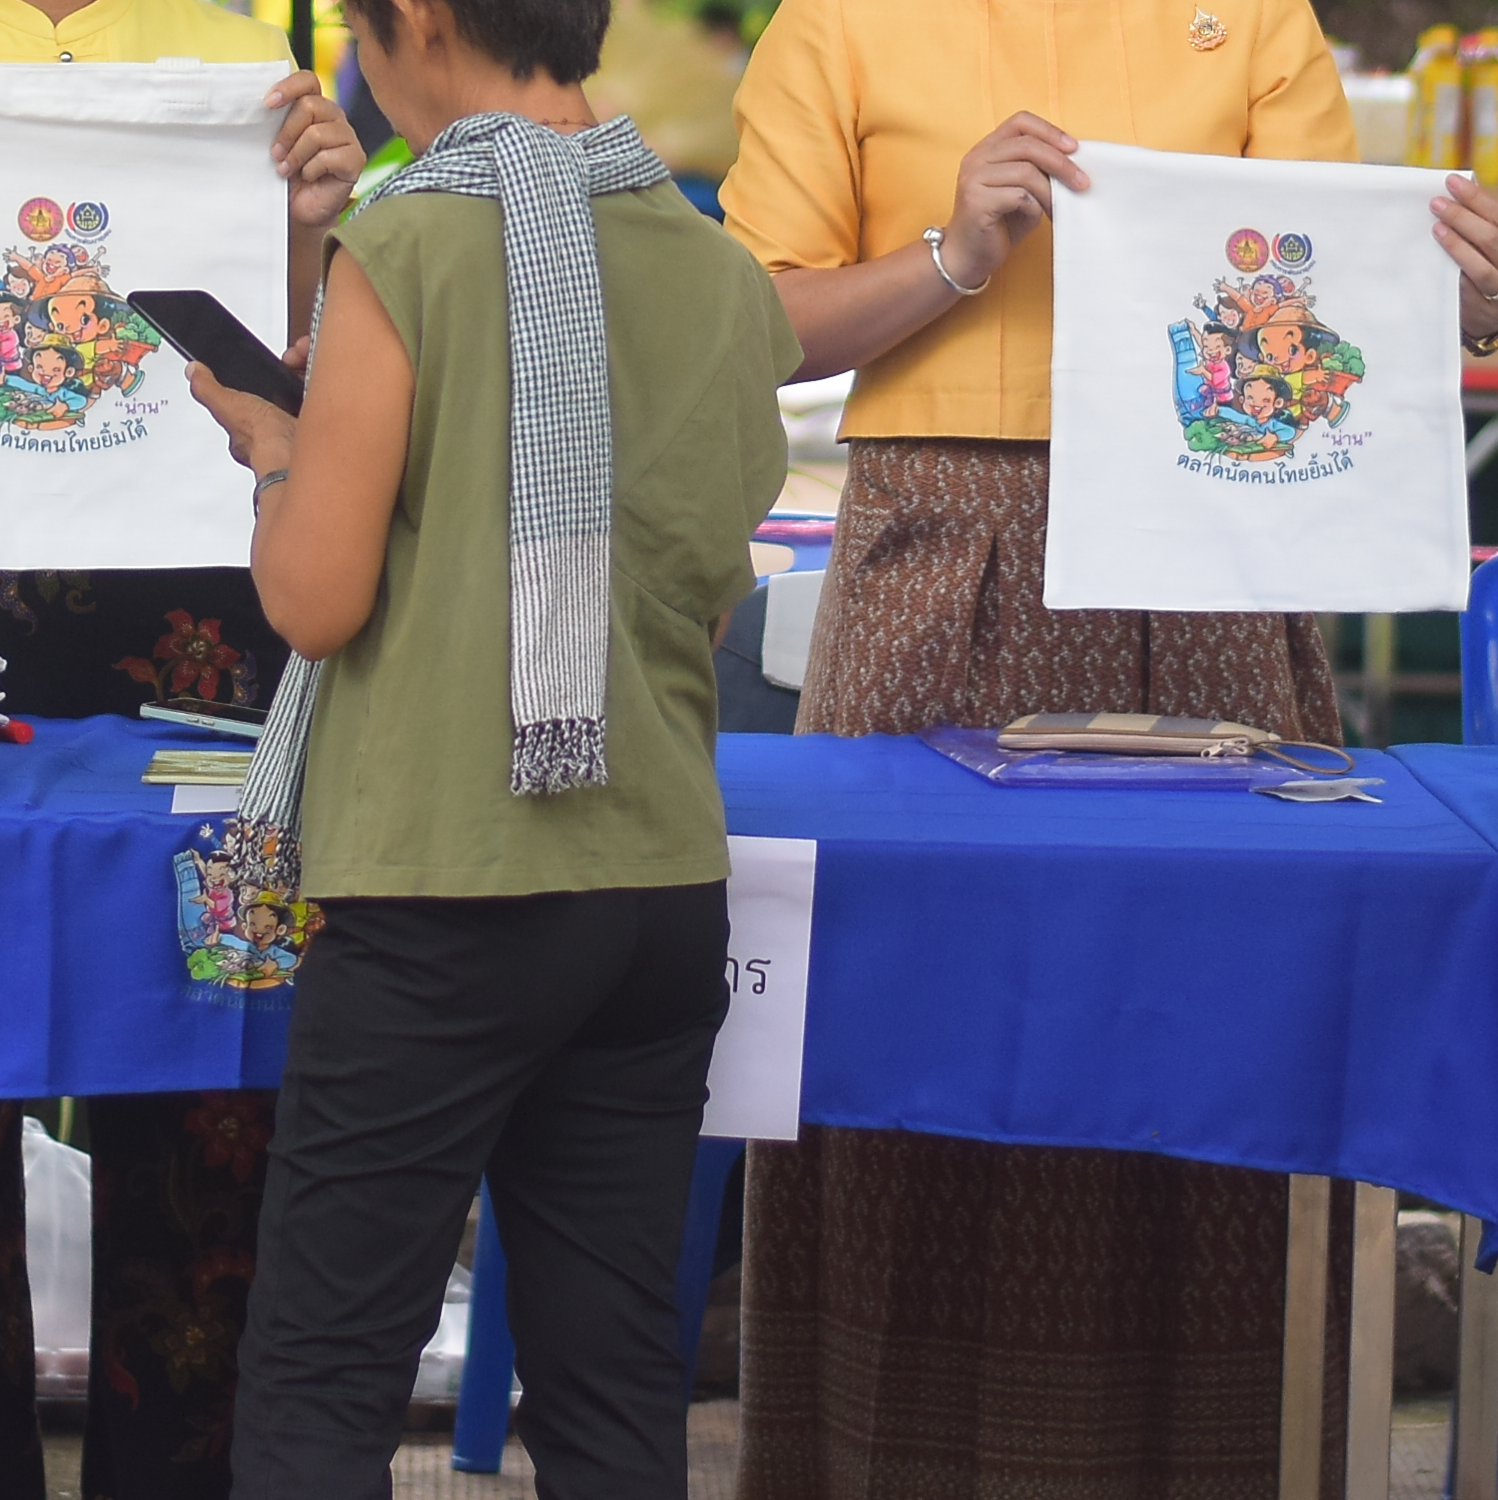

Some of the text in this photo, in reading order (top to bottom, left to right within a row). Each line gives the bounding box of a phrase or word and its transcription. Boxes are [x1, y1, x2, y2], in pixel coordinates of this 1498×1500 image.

[114, 396, 169, 414] “น่าน”
[1322, 427, 1373, 446] “น่าน”
[1176, 448, 1354, 485] ตลาดนัดคนไทยยิ้มได้
